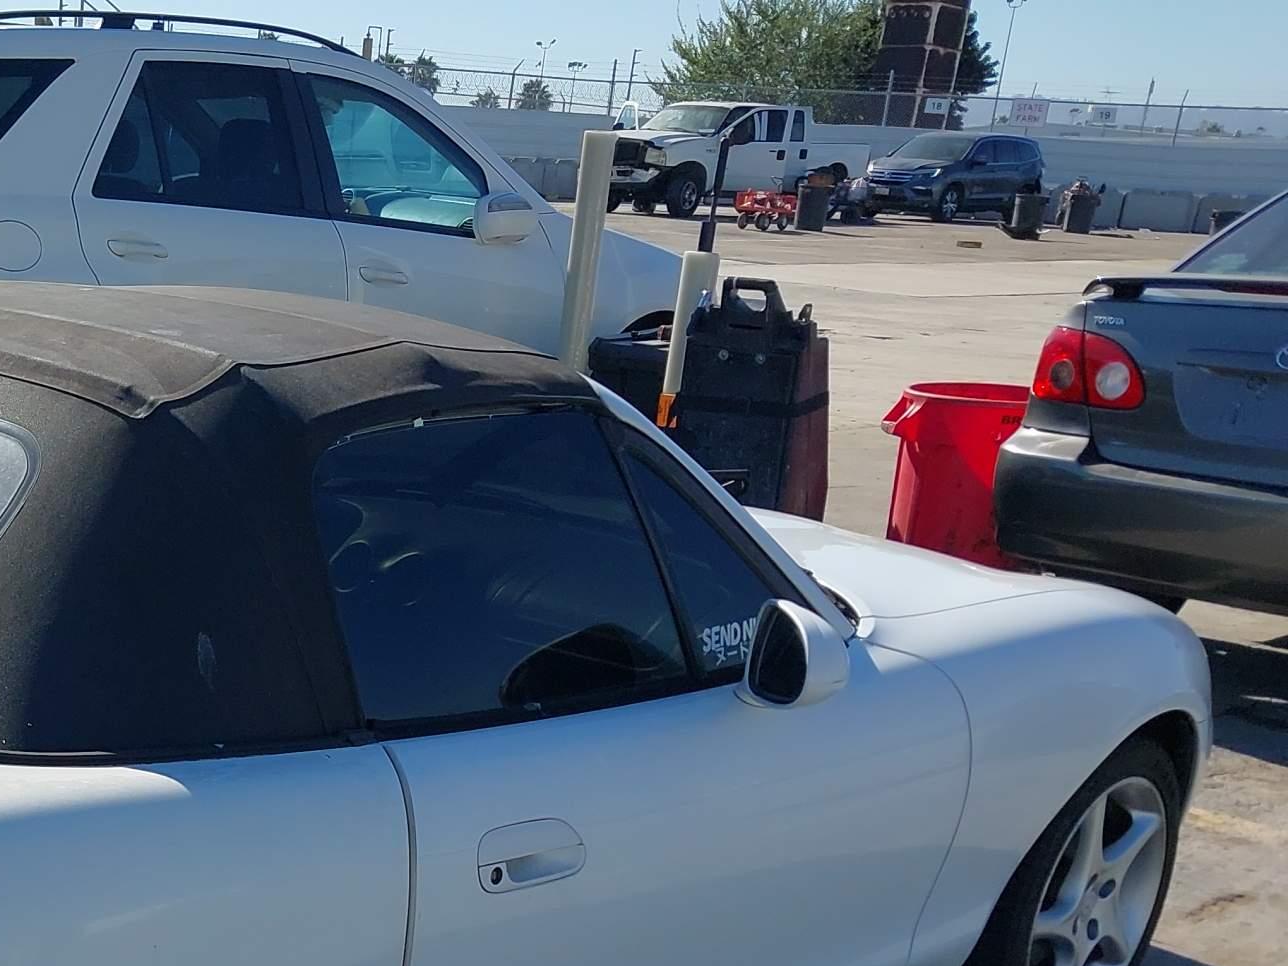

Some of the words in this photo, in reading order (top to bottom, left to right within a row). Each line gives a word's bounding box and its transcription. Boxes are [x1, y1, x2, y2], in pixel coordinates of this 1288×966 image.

[931, 102, 943, 111] 18
[1016, 103, 1044, 113] STATE
[1016, 114, 1040, 123] FARM
[1099, 111, 1111, 120] 19
[1093, 315, 1125, 325] TOYOTA
[702, 621, 741, 655] SEND
[742, 617, 757, 642] N
